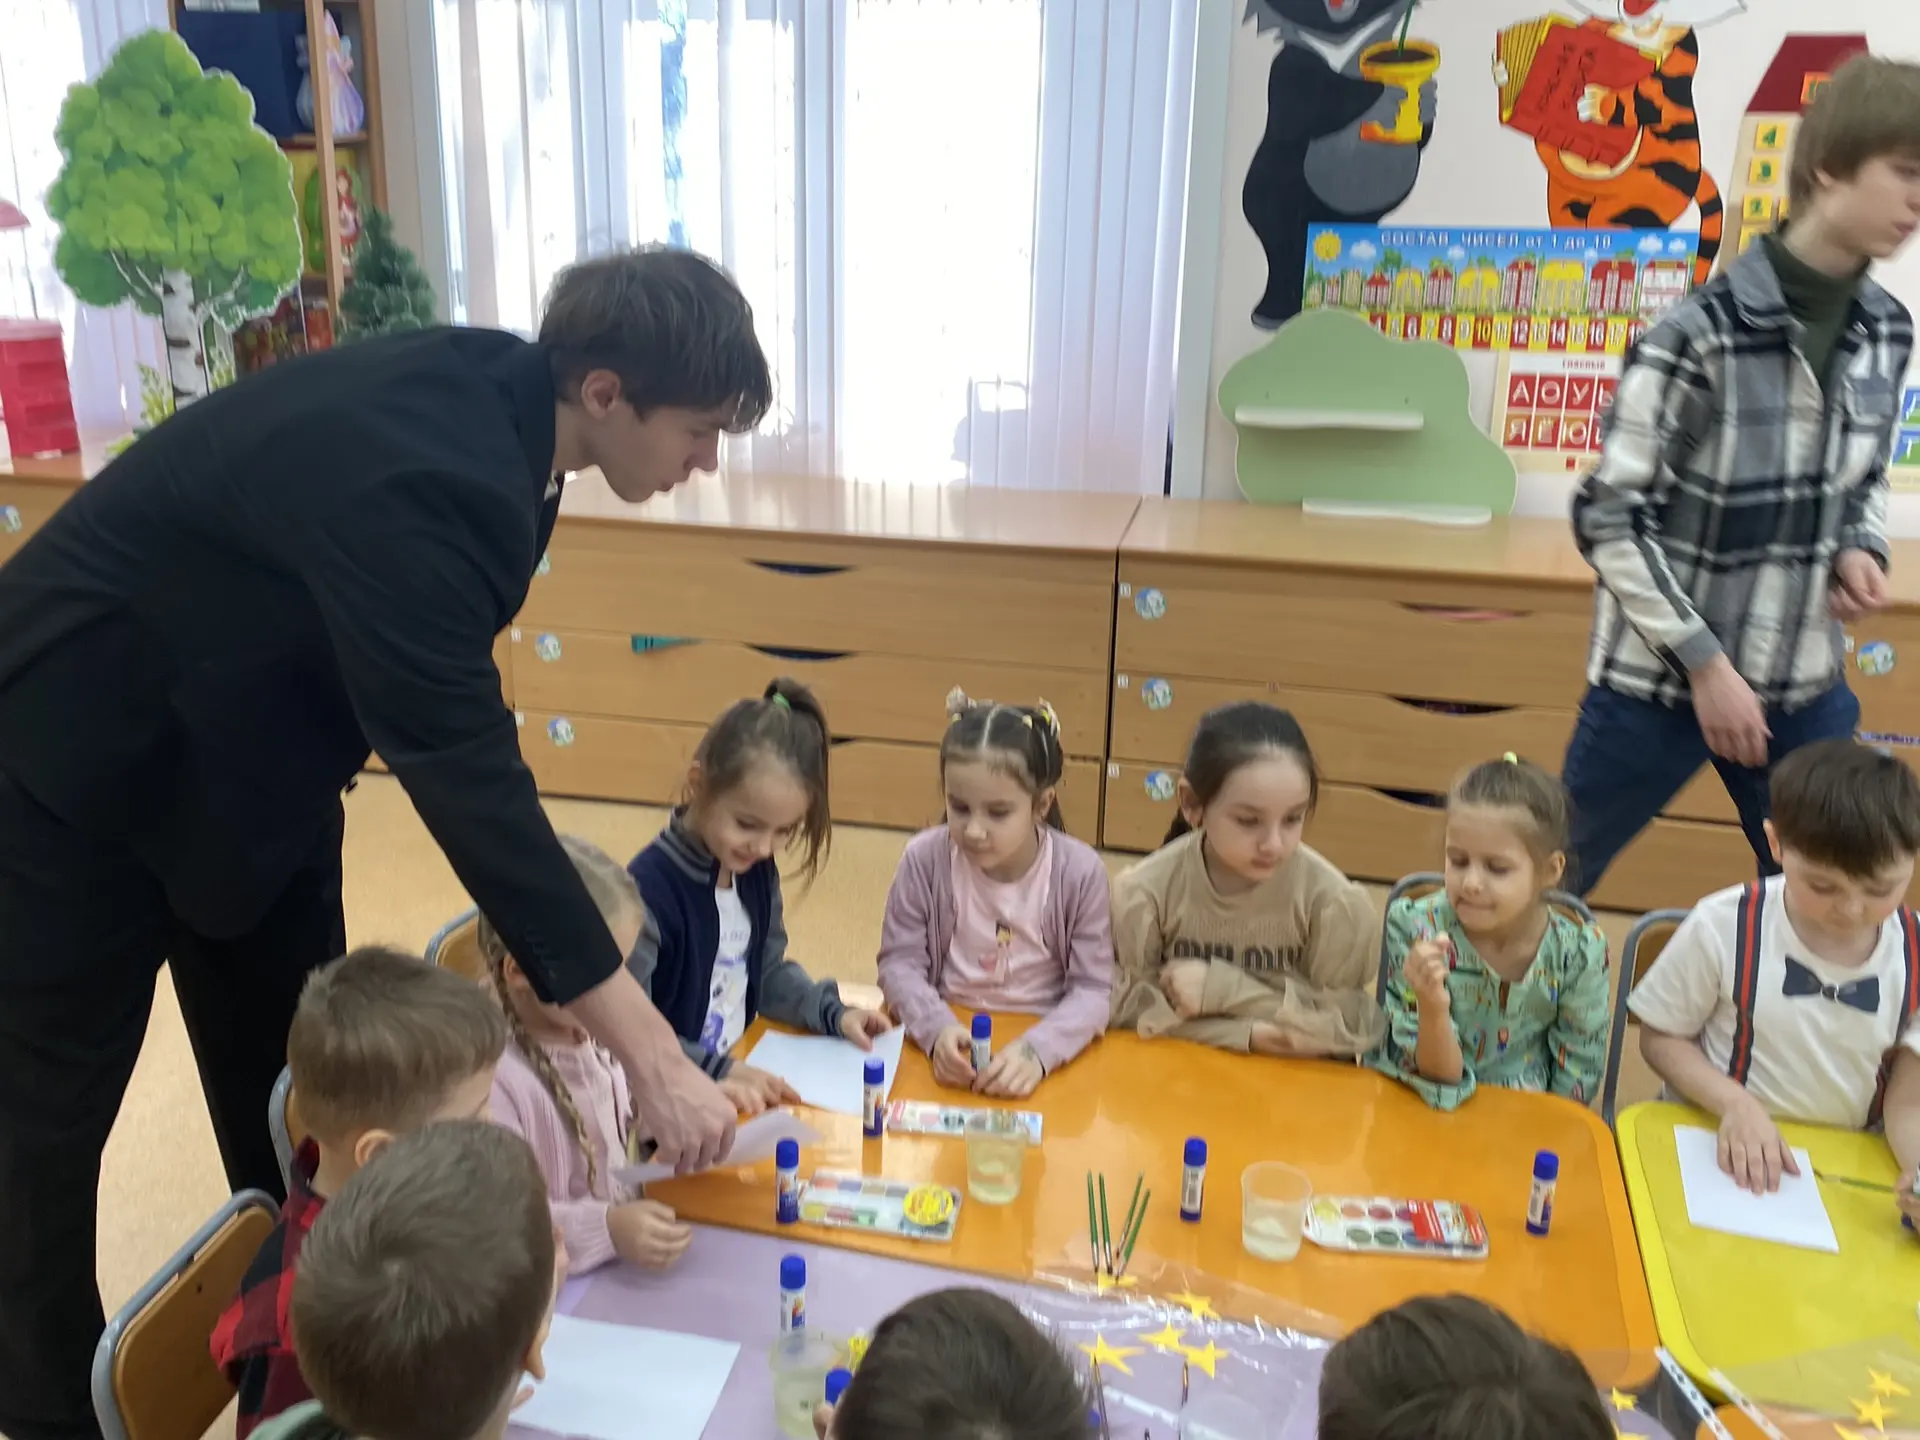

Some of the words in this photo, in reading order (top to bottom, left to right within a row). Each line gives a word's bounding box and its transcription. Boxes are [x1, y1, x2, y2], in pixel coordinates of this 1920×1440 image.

[1381, 230, 1449, 246] СОСТАВ
[1461, 231, 1519, 248] ЧИСЕЛ
[1525, 236, 1543, 248] от
[1551, 234, 1558, 248] 1
[1563, 236, 1586, 250] до
[1593, 234, 1611, 249] 10
[1477, 319, 1490, 343] 10
[1495, 320, 1508, 343] 11
[1513, 319, 1528, 344] 12
[1551, 320, 1566, 345] 14
[1609, 322, 1624, 346] 17
[1512, 380, 1530, 404] А
[1541, 380, 1561, 405] О
[1572, 381, 1590, 405] У
[1509, 418, 1527, 442] Я
[1562, 421, 1588, 445] Ю
